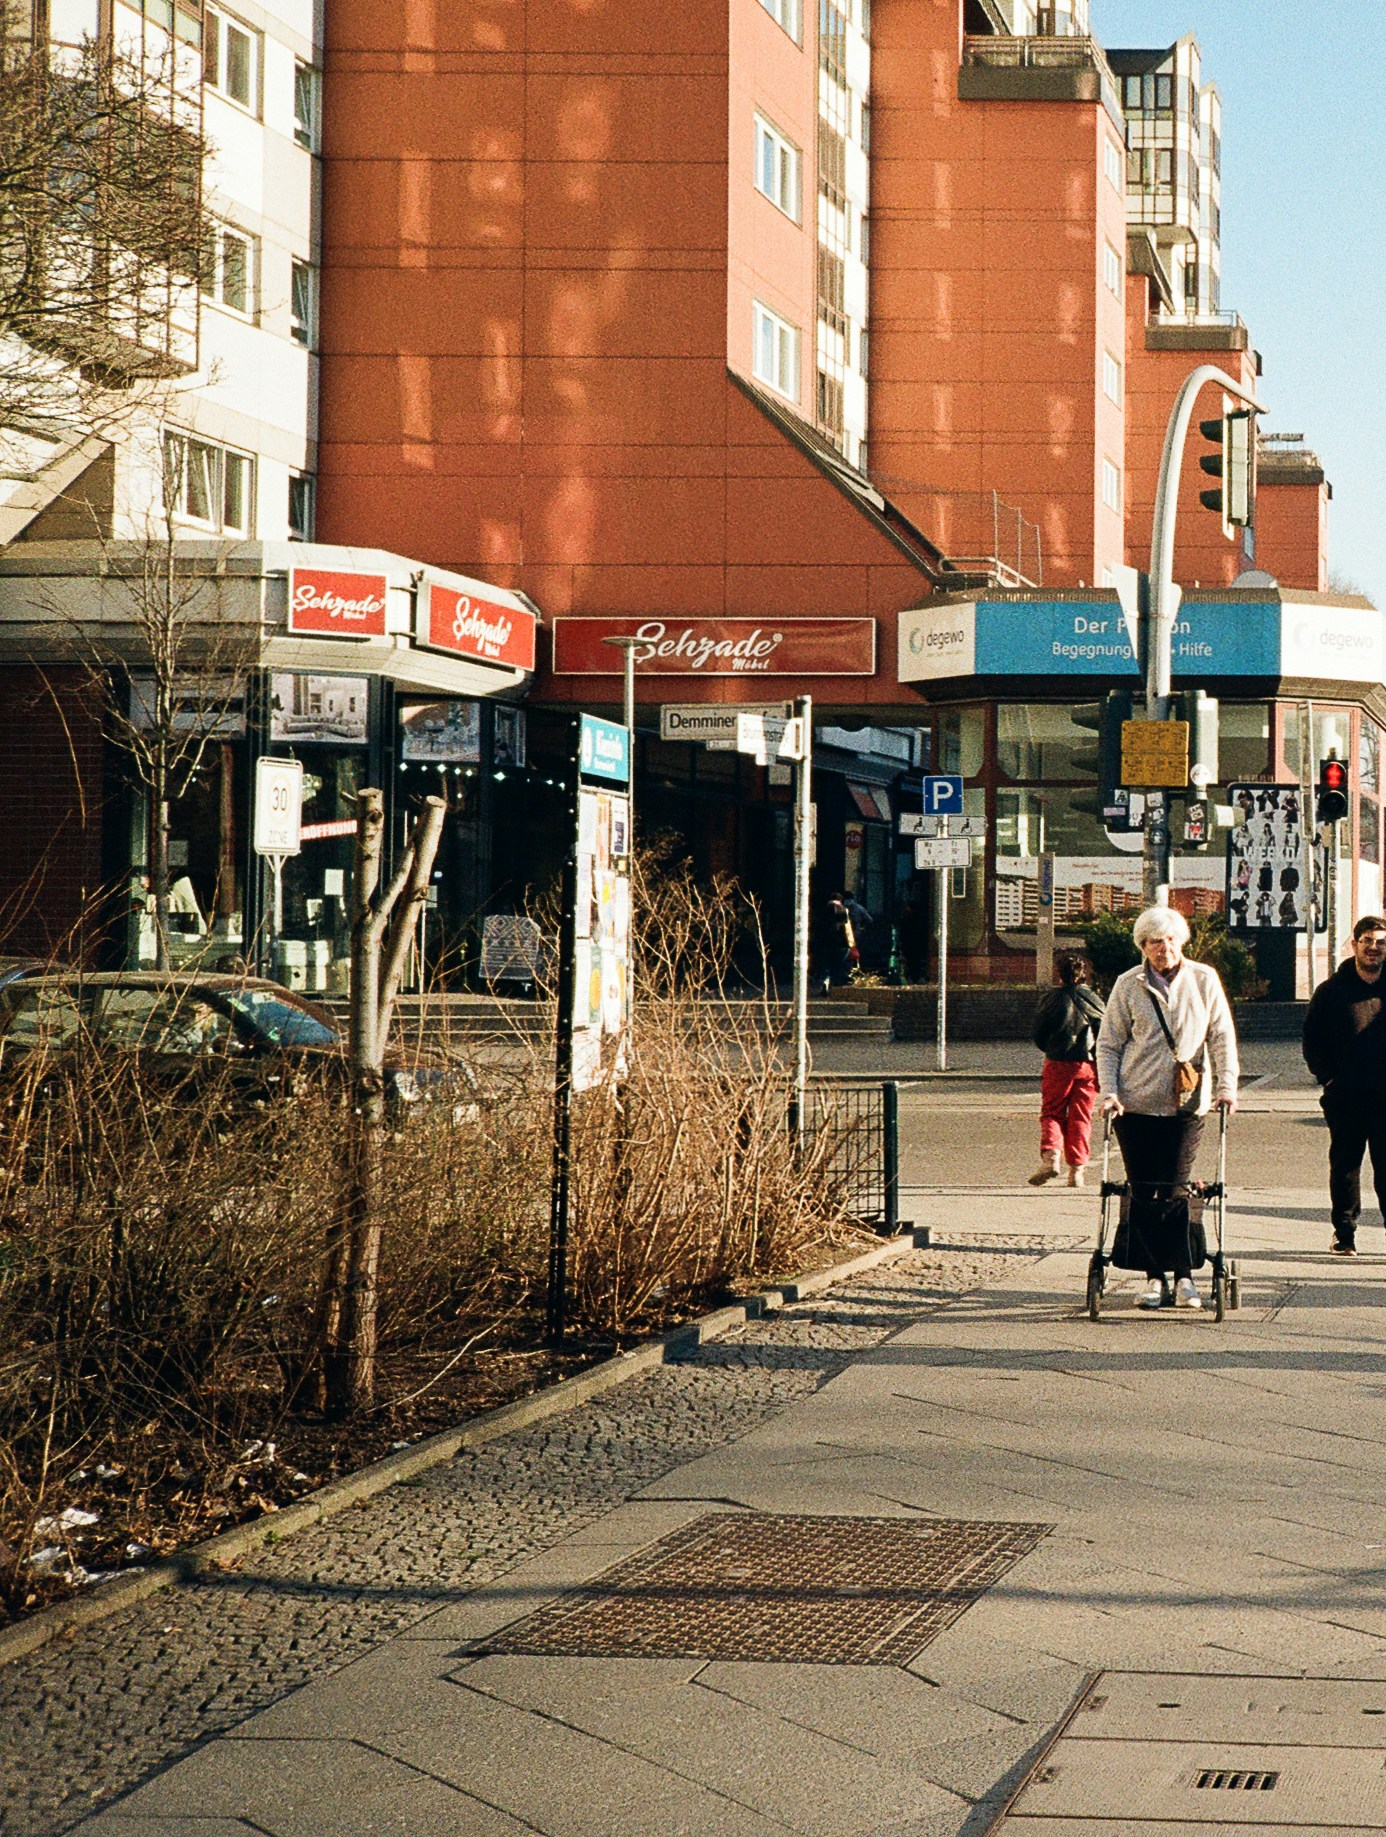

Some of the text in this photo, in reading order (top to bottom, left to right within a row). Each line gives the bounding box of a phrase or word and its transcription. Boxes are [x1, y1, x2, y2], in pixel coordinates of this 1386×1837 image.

[1074, 616, 1109, 634] Der
[926, 628, 964, 649] degewo
[1179, 641, 1213, 656] Hilfe
[1320, 628, 1374, 650] degewo
[669, 712, 736, 729] Demminer
[273, 787, 287, 811] 30
[933, 781, 954, 810] P
